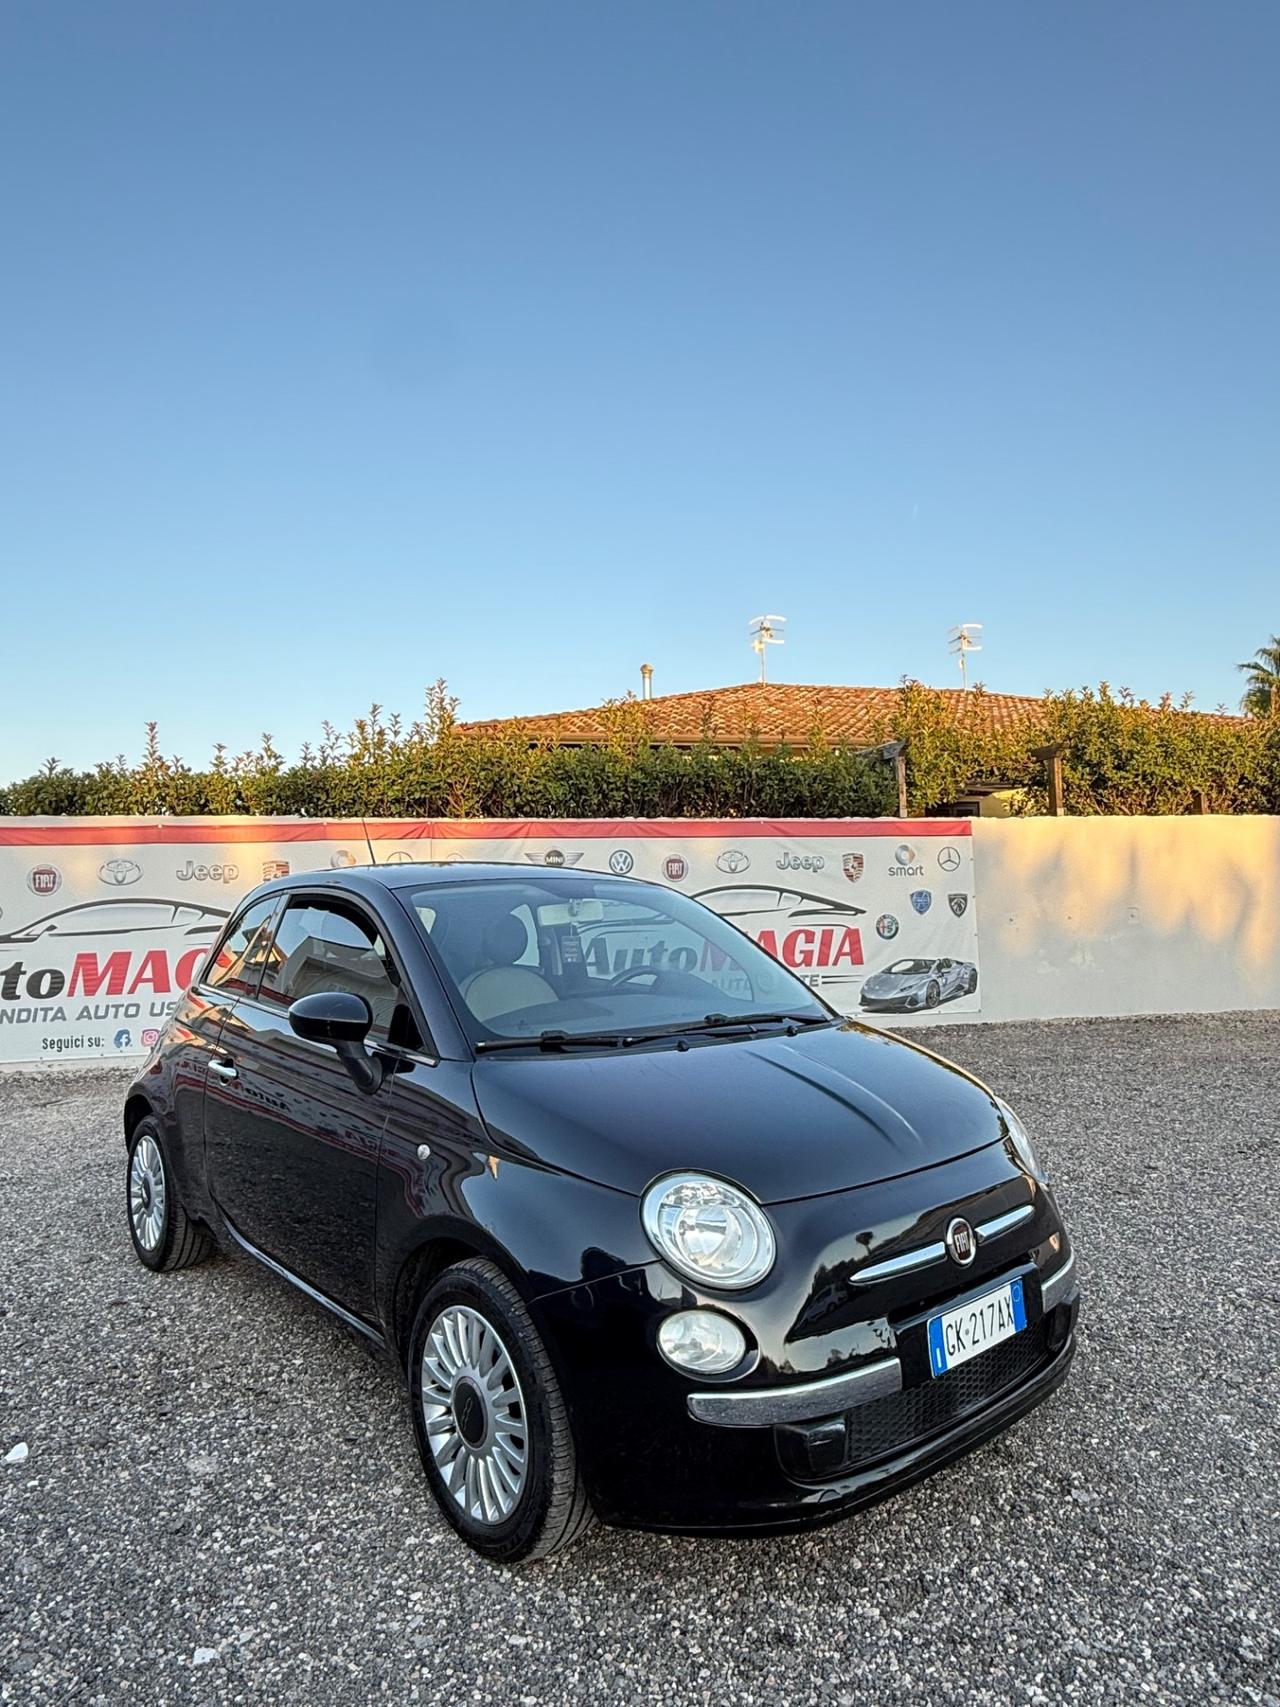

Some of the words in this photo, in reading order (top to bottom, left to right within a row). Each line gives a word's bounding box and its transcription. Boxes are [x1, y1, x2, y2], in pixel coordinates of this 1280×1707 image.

[667, 861, 683, 875] FIAT
[776, 852, 824, 872] Jeep
[888, 865, 924, 876] smart
[176, 860, 239, 883] Jeep
[34, 873, 56, 889] FIAT
[76, 1003, 141, 1021] AUTO
[42, 1034, 85, 1053] Seguici
[954, 1231, 971, 1254] FIAT
